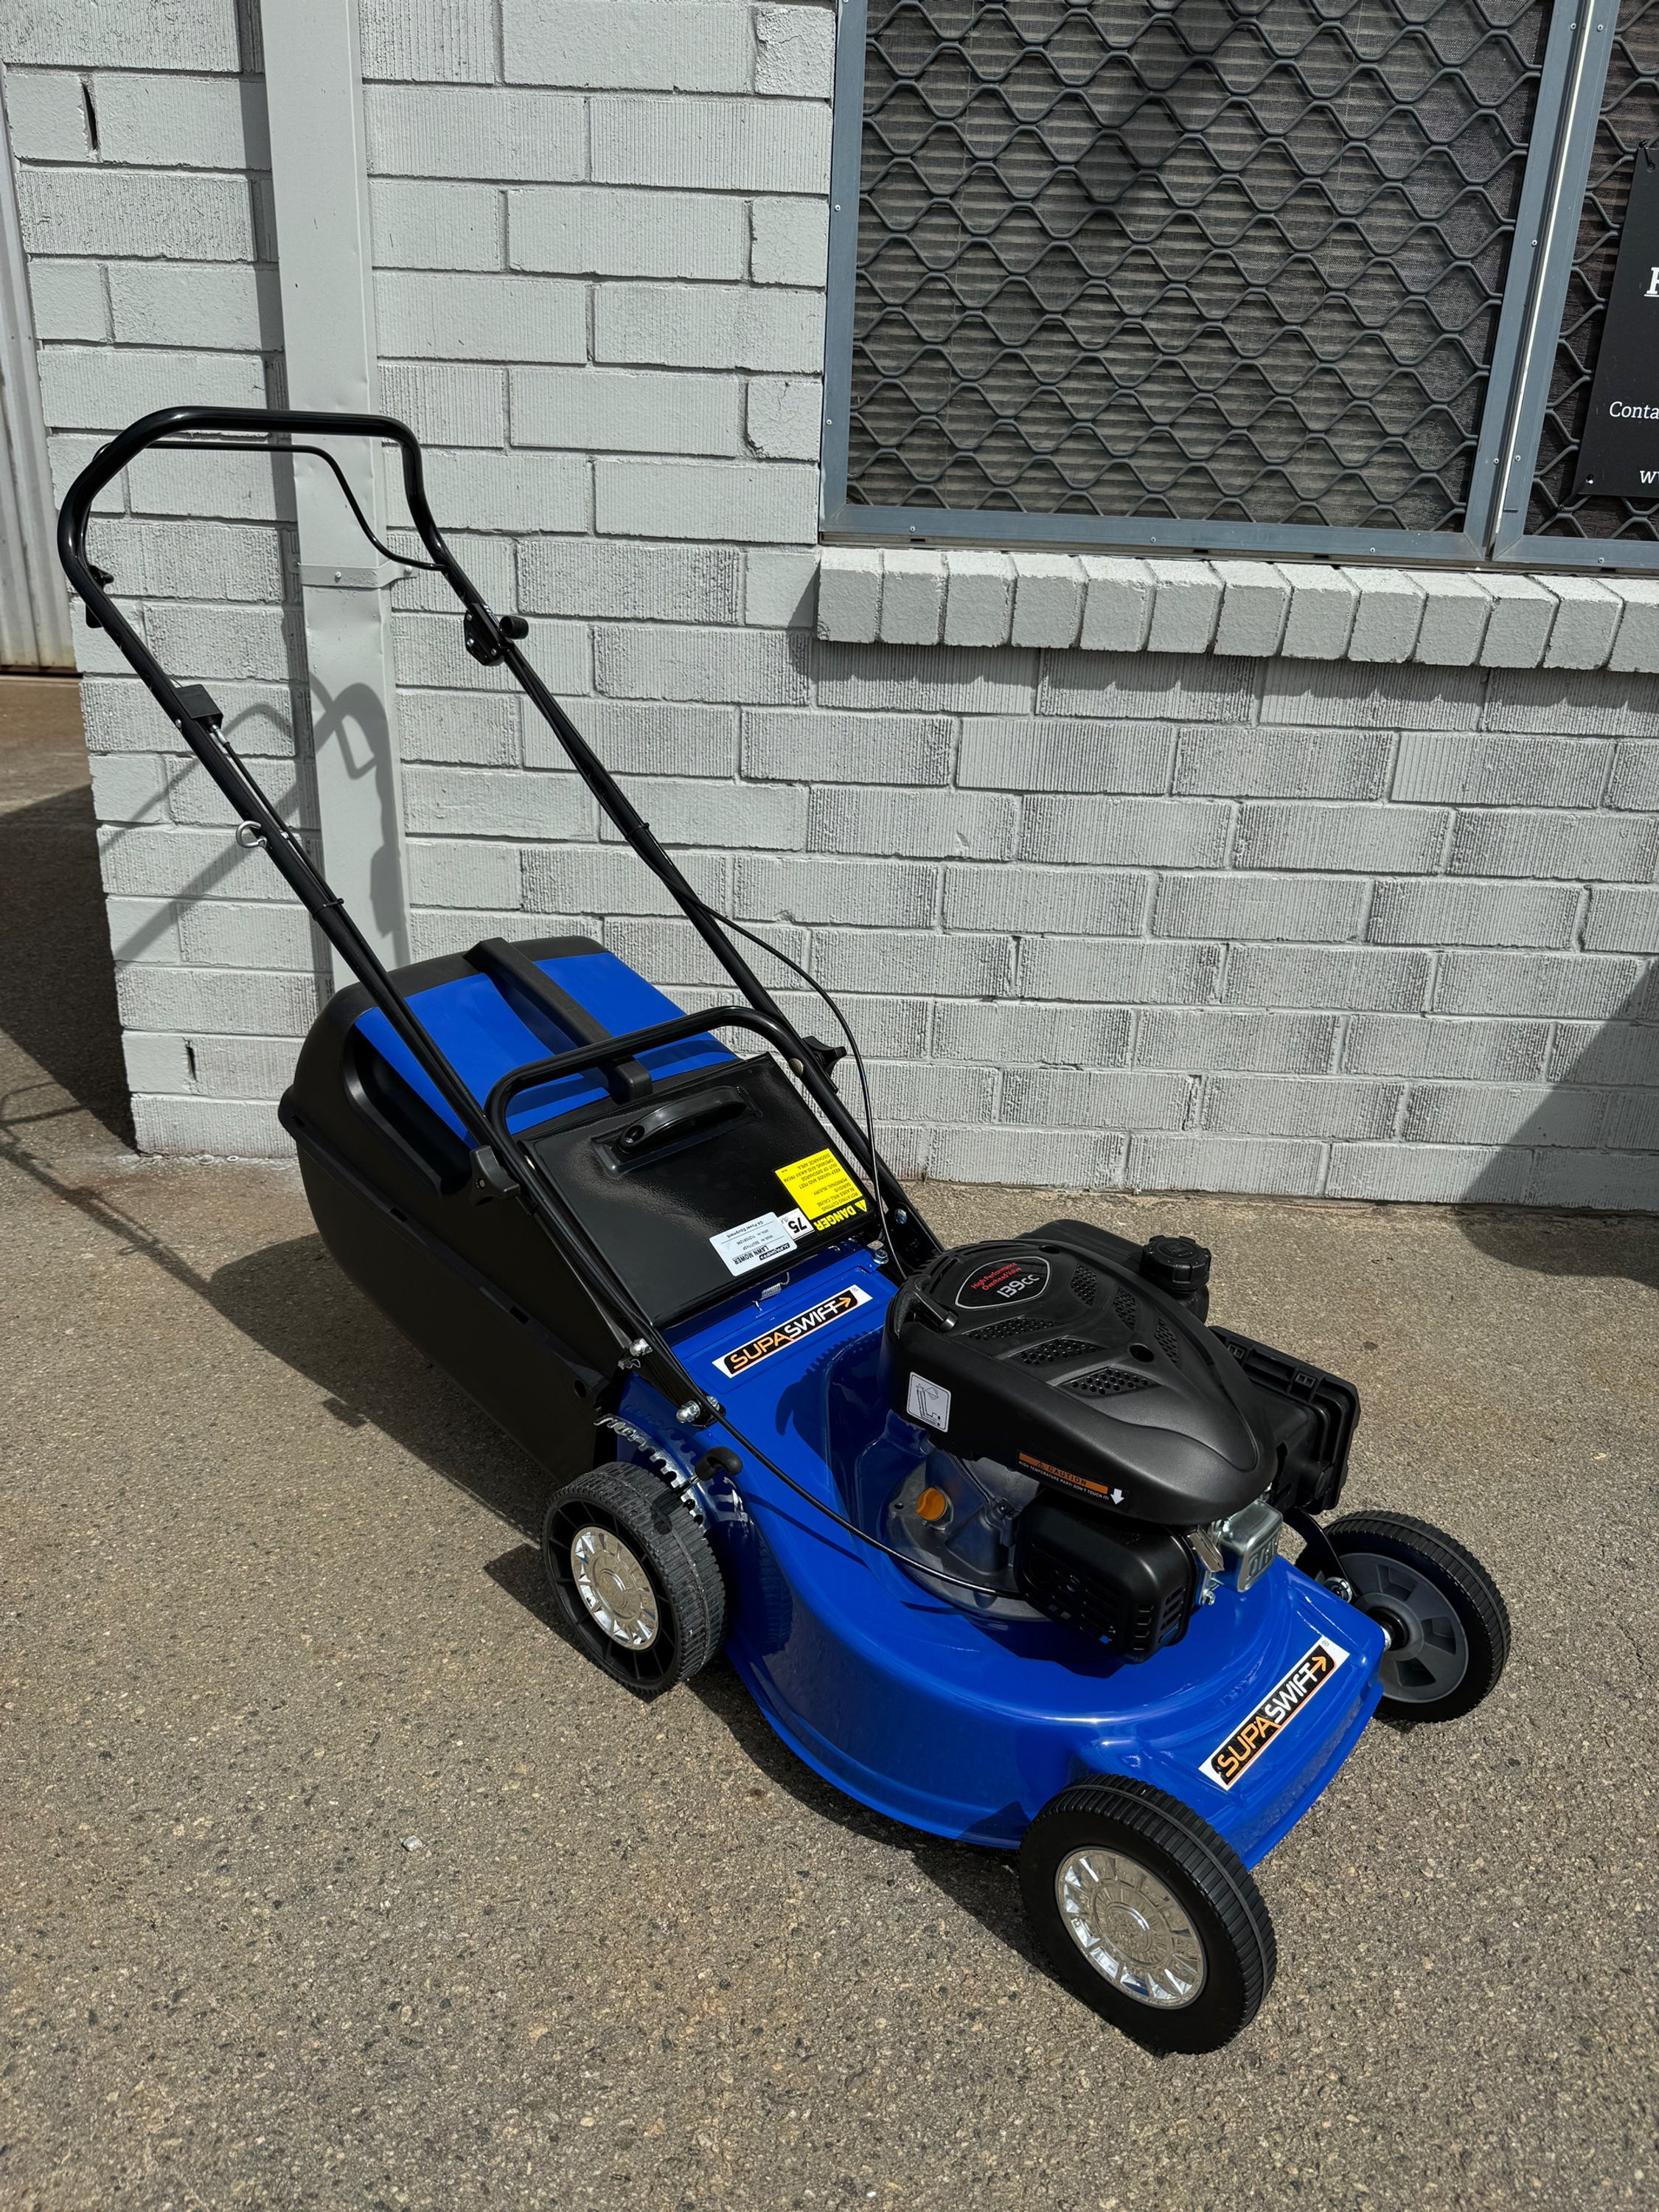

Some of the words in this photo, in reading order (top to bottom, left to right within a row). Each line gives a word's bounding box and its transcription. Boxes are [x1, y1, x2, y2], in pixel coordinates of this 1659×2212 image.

[816, 1172, 831, 1180] HANDS
[827, 1178, 848, 1188] PERSONAL
[839, 1187, 855, 1196] BLADES
[816, 1198, 831, 1206] CAUSE
[821, 1201, 839, 1211] CUTTING
[813, 1205, 857, 1231] DANGER
[787, 1217, 808, 1234] 75
[726, 1227, 746, 1238] Equipment
[753, 1245, 769, 1256] LAWN
[733, 1252, 754, 1265] MOWER
[996, 1274, 1040, 1298] 139cc
[730, 1300, 838, 1370] SUPASWIFT
[1029, 1464, 1060, 1482] TEMPERATURE
[1087, 1489, 1103, 1498] TOUCH
[1048, 1466, 1087, 1486] CAUTION
[1217, 1661, 1318, 1778] SUPASWIFT
